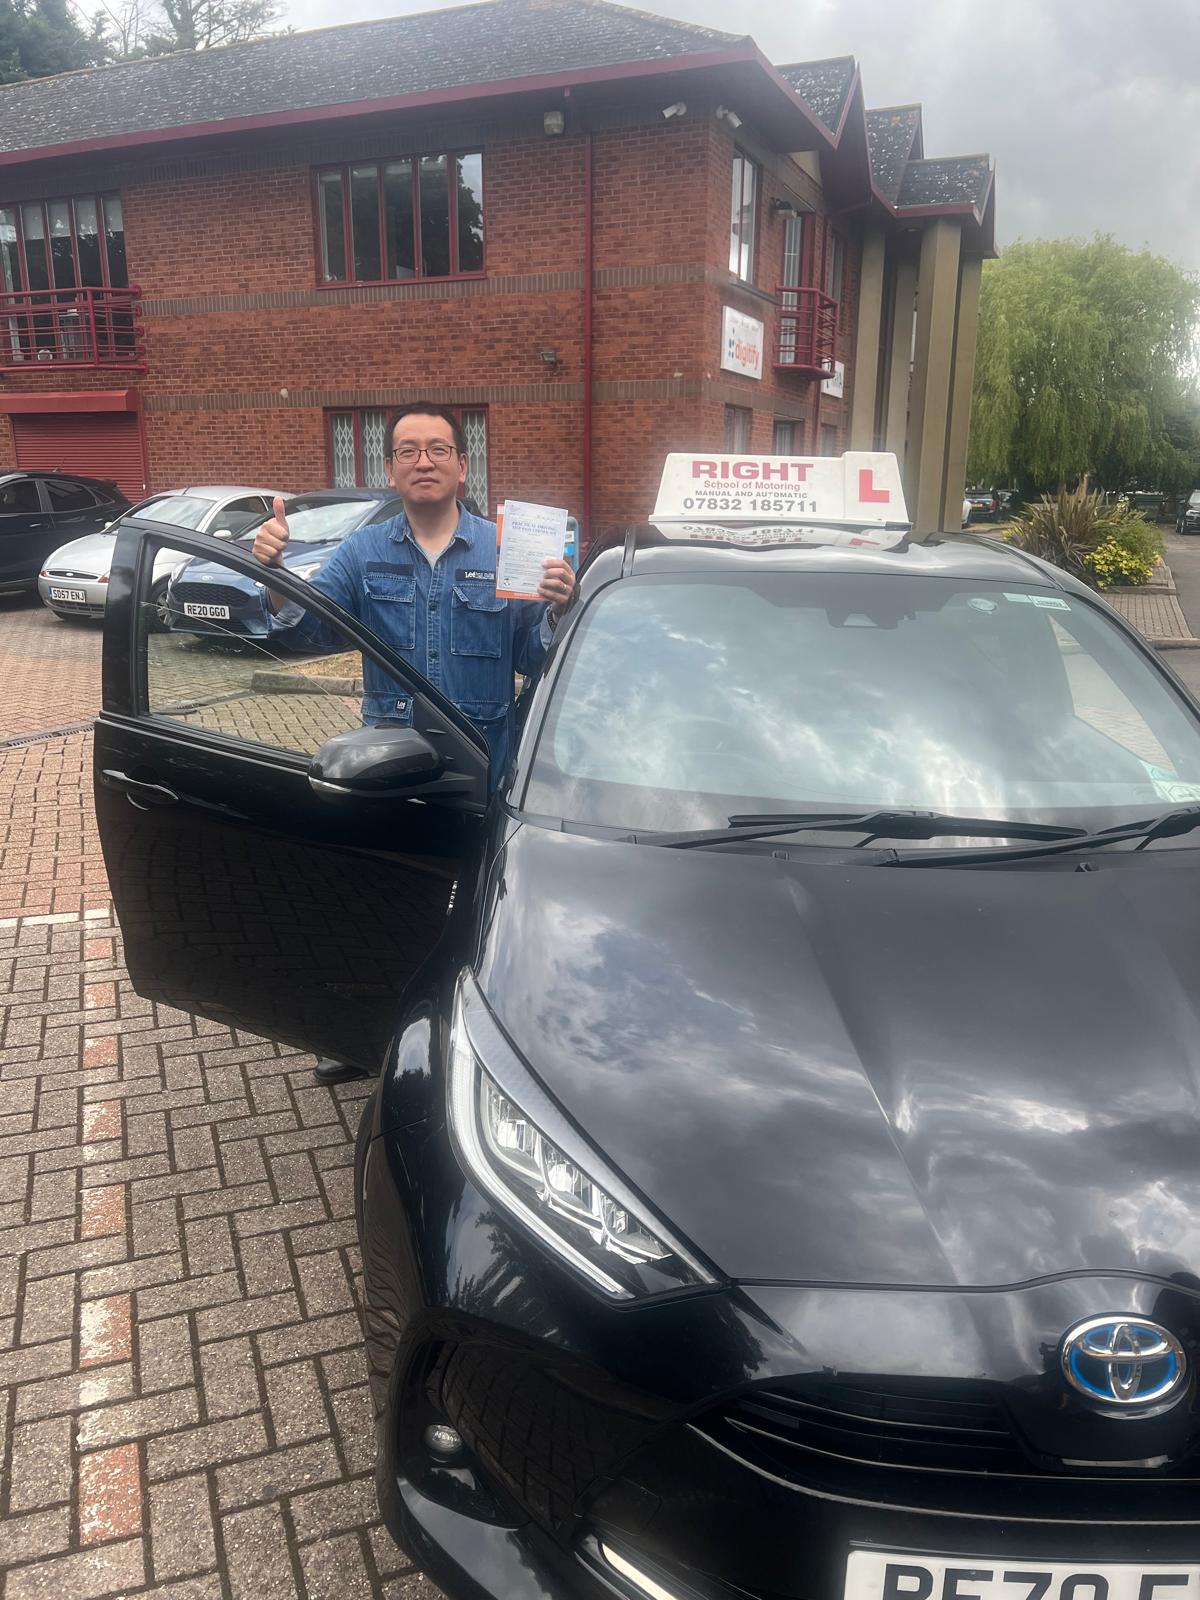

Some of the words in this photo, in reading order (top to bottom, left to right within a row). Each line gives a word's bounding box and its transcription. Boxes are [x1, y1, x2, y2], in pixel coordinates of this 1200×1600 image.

[692, 460, 814, 481] RIGHT
[704, 480, 739, 490] School
[742, 481, 752, 490] of
[755, 481, 801, 492] Motoring
[858, 469, 890, 504] L
[755, 491, 808, 499] AUTOMATIC
[683, 498, 742, 511] 07832
[749, 499, 817, 513] 185711
[70, 591, 85, 601] ENJ
[187, 605, 208, 615] RE20
[209, 606, 226, 617] GGO
